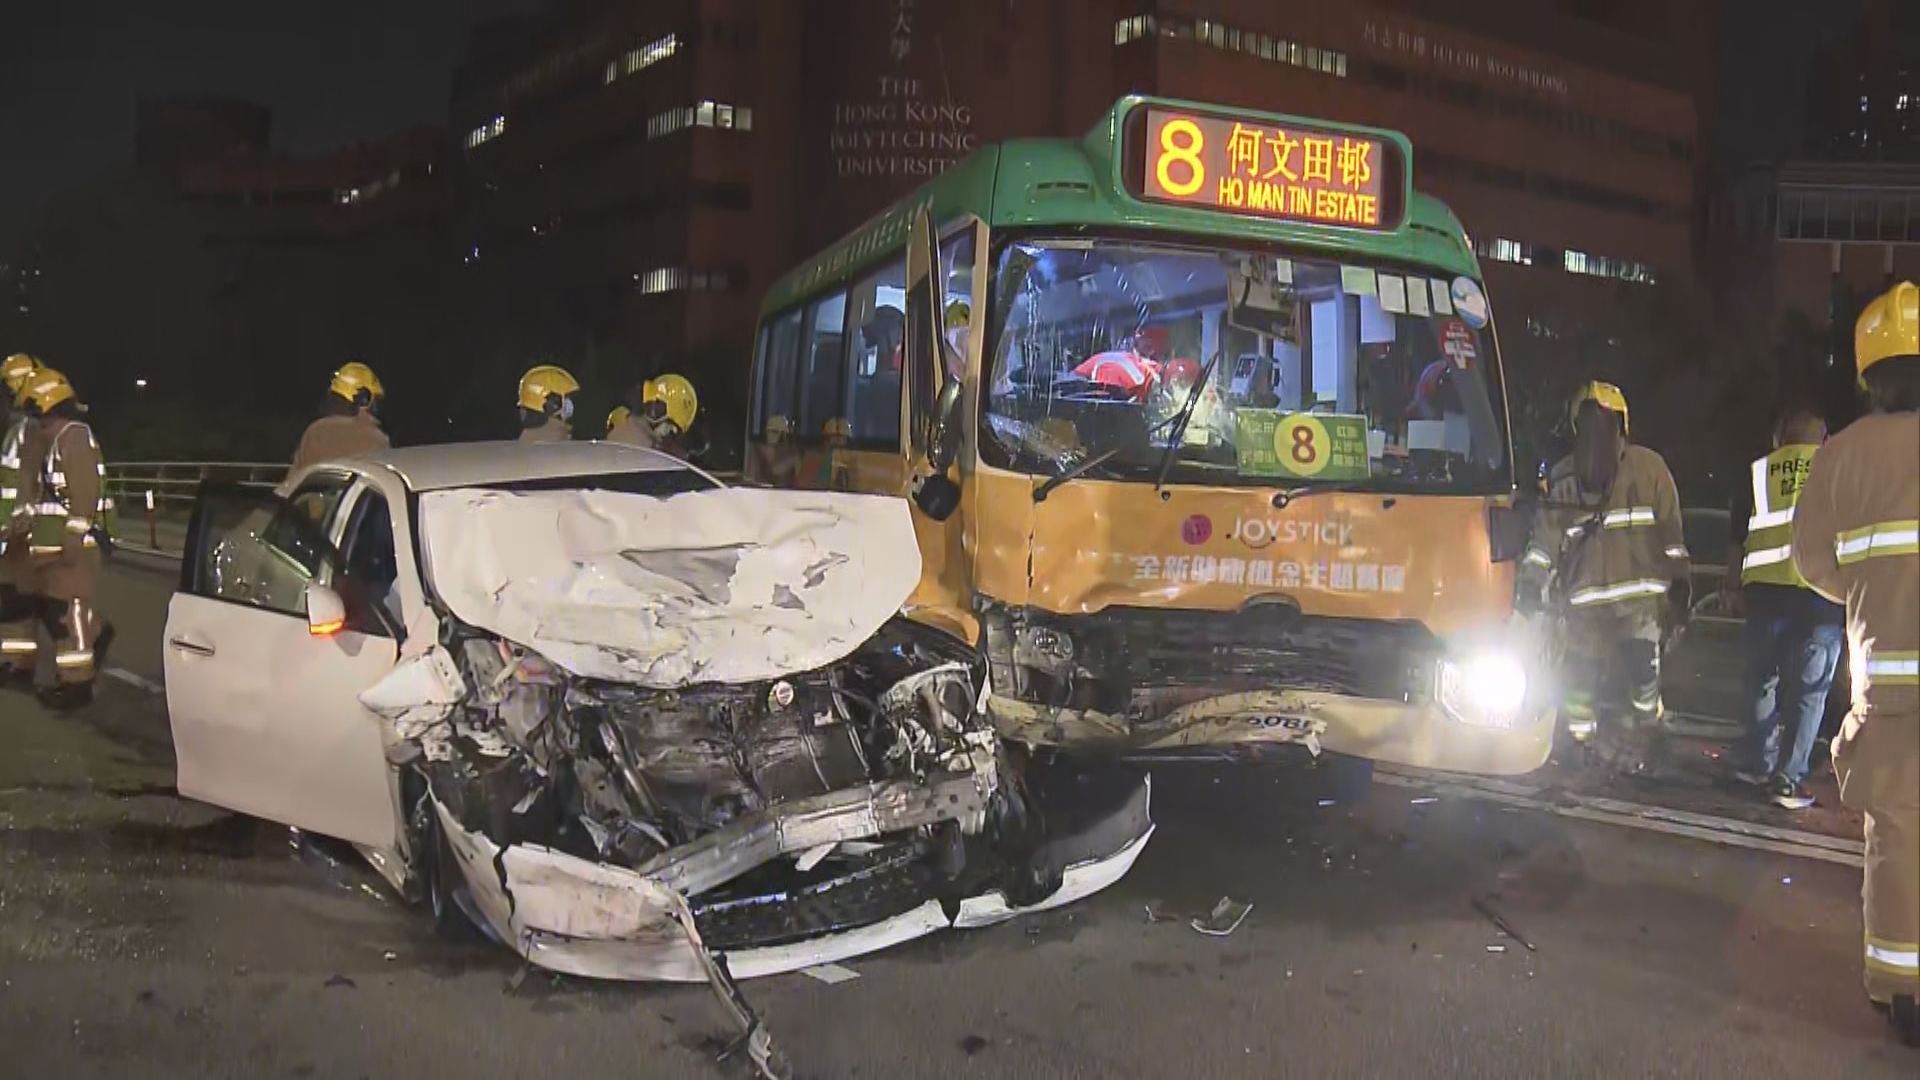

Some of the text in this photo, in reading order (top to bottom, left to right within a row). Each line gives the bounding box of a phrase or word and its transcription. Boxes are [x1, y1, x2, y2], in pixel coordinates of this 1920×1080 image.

[878, 76, 920, 97] THE
[835, 101, 971, 125] HONG KONG
[831, 129, 975, 151] POLYTECHNIC
[1227, 121, 1372, 191] 何文田邨
[1156, 119, 1205, 196] 8
[1218, 176, 1377, 225] HO MAN TIN ESTATE
[1292, 425, 1316, 463] 8
[1233, 518, 1353, 546] JOYSTICK
